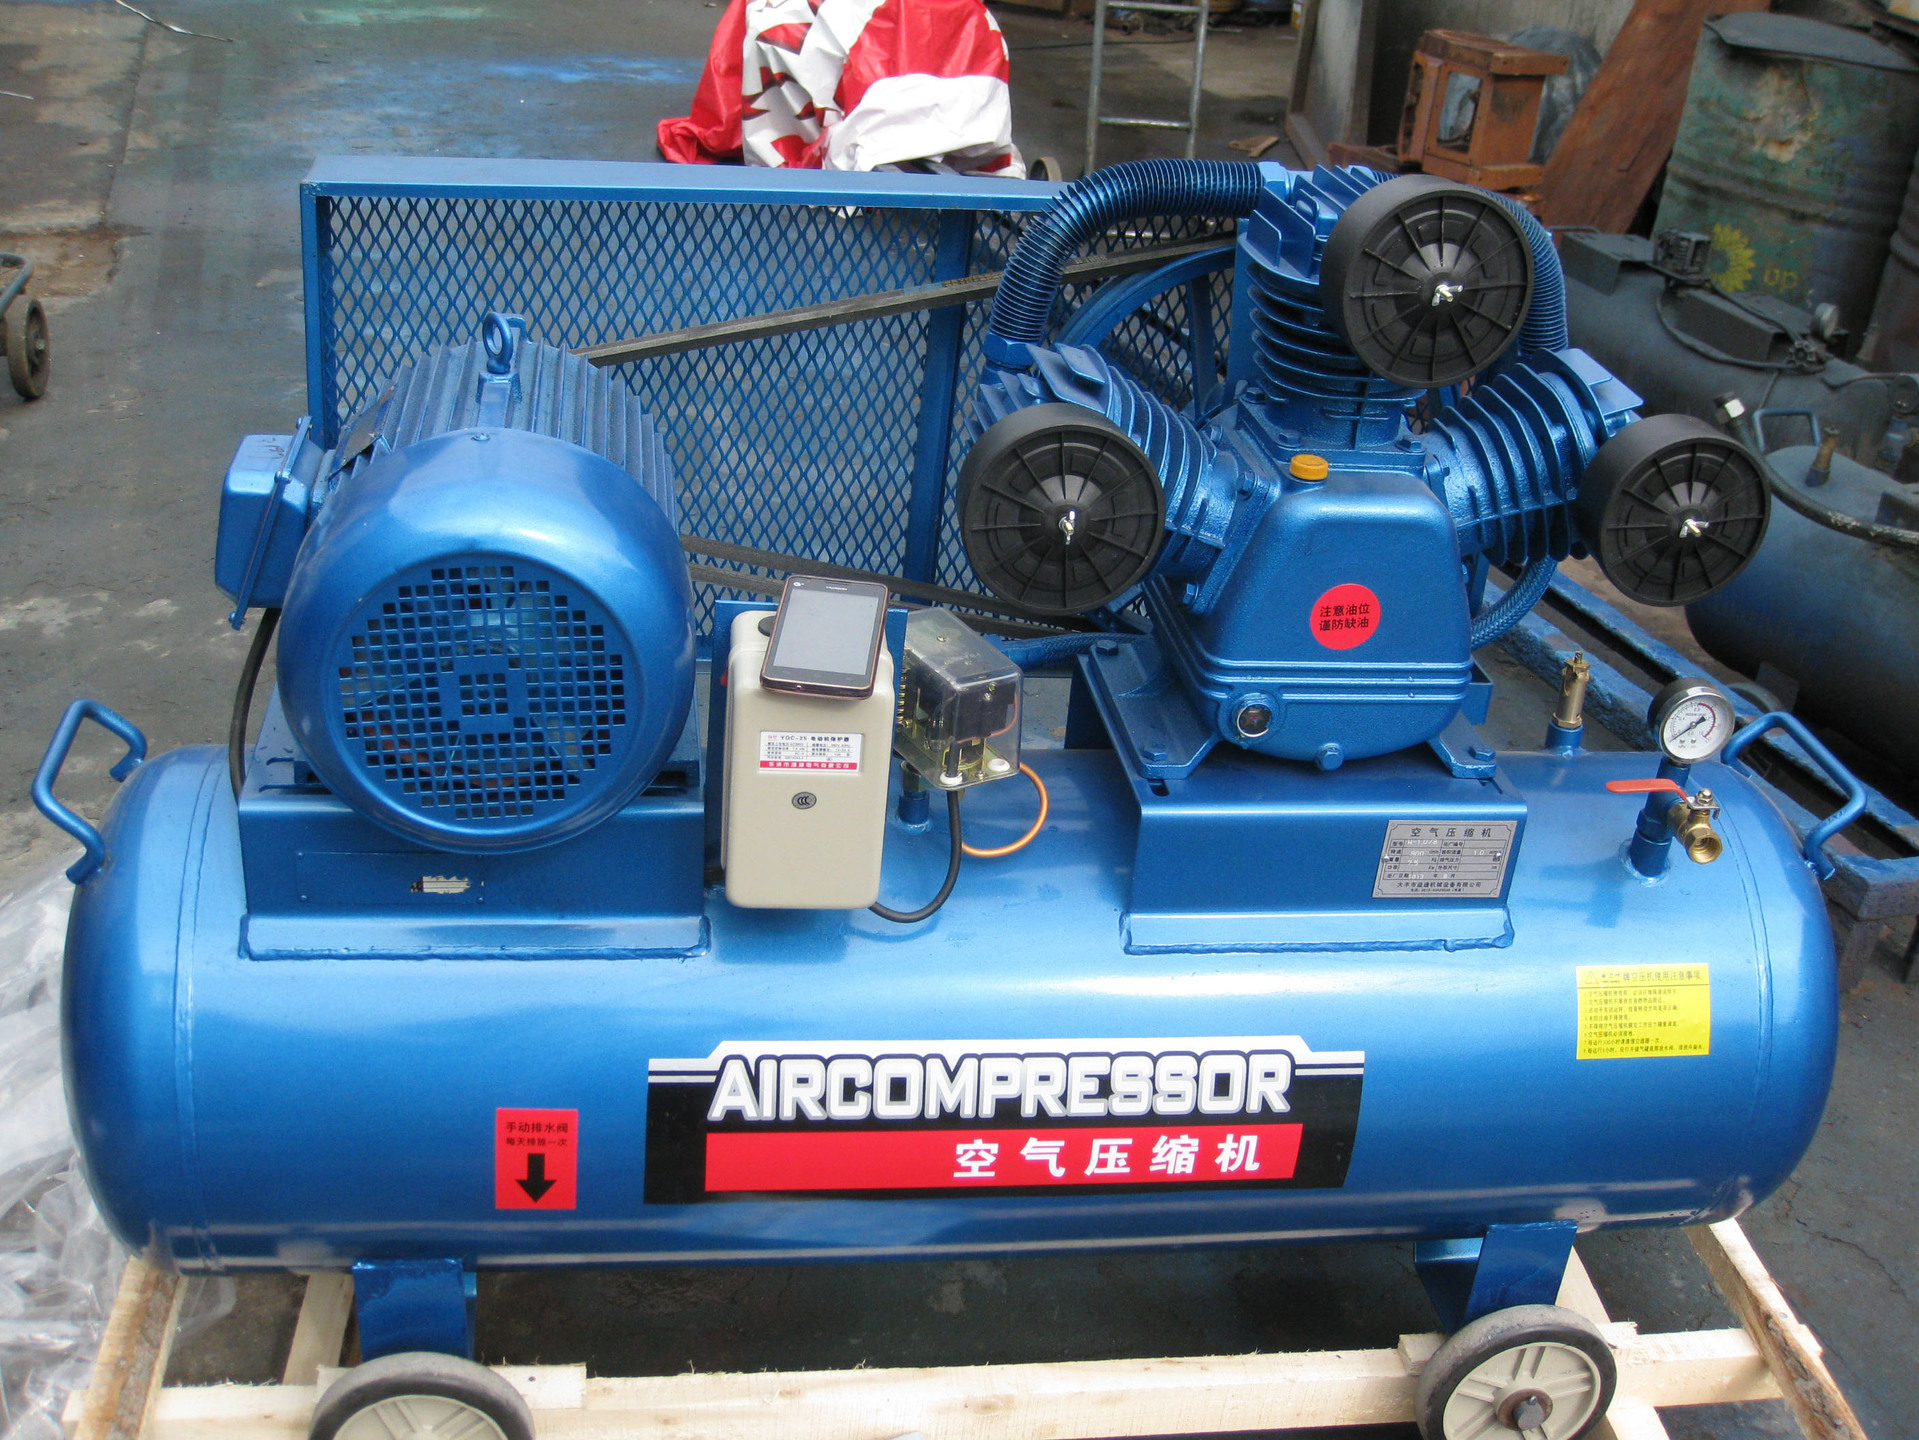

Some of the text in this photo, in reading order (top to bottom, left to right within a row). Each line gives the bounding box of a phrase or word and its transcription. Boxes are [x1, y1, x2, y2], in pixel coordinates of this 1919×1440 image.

[1320, 603, 1371, 617] 注意油位
[1319, 617, 1369, 631] 谨防缺油
[1410, 827, 1492, 838] 空气压缩机
[707, 1054, 1291, 1121] AIRCOMPRESSOR
[505, 1122, 569, 1133] 手动排水阀
[953, 1134, 1261, 1178] 空气压缩机
